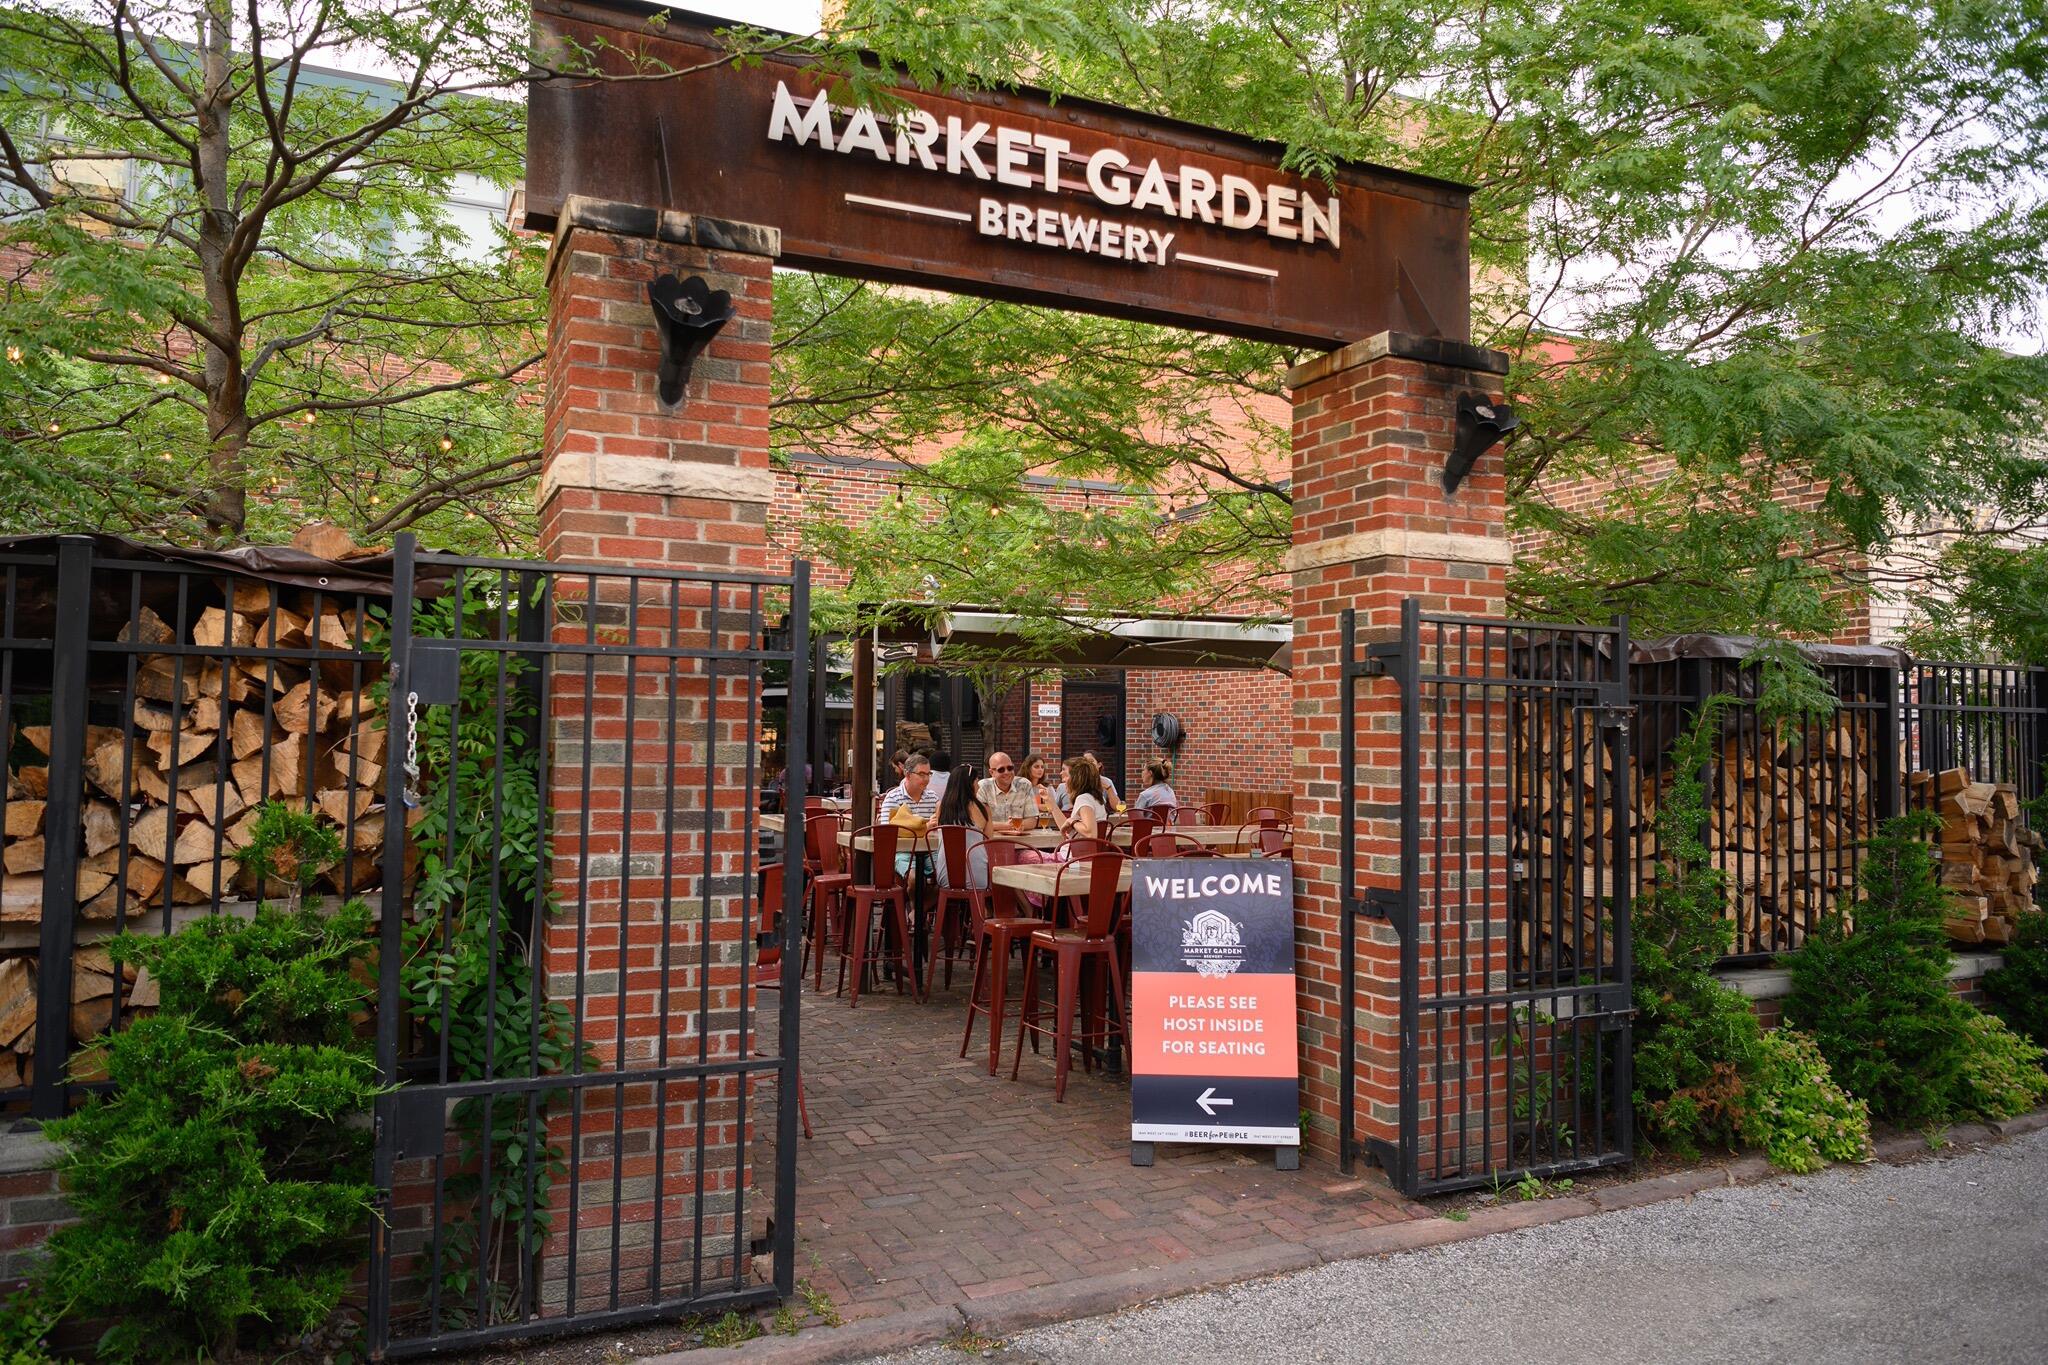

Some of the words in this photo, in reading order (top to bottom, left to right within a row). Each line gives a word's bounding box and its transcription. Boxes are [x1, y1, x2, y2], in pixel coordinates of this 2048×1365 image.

[767, 80, 1071, 193] MARKET
[1086, 149, 1340, 249] GARDEN
[979, 198, 1175, 266] BREWERY
[1145, 873, 1282, 899] WELCOME
[1169, 995, 1225, 1009] PLEASE
[1229, 996, 1257, 1009] SEE
[1163, 1018, 1205, 1031] HOST
[1210, 1018, 1264, 1033] INSIDE
[1162, 1040, 1194, 1054] FOR
[1199, 1041, 1265, 1055] SEATING
